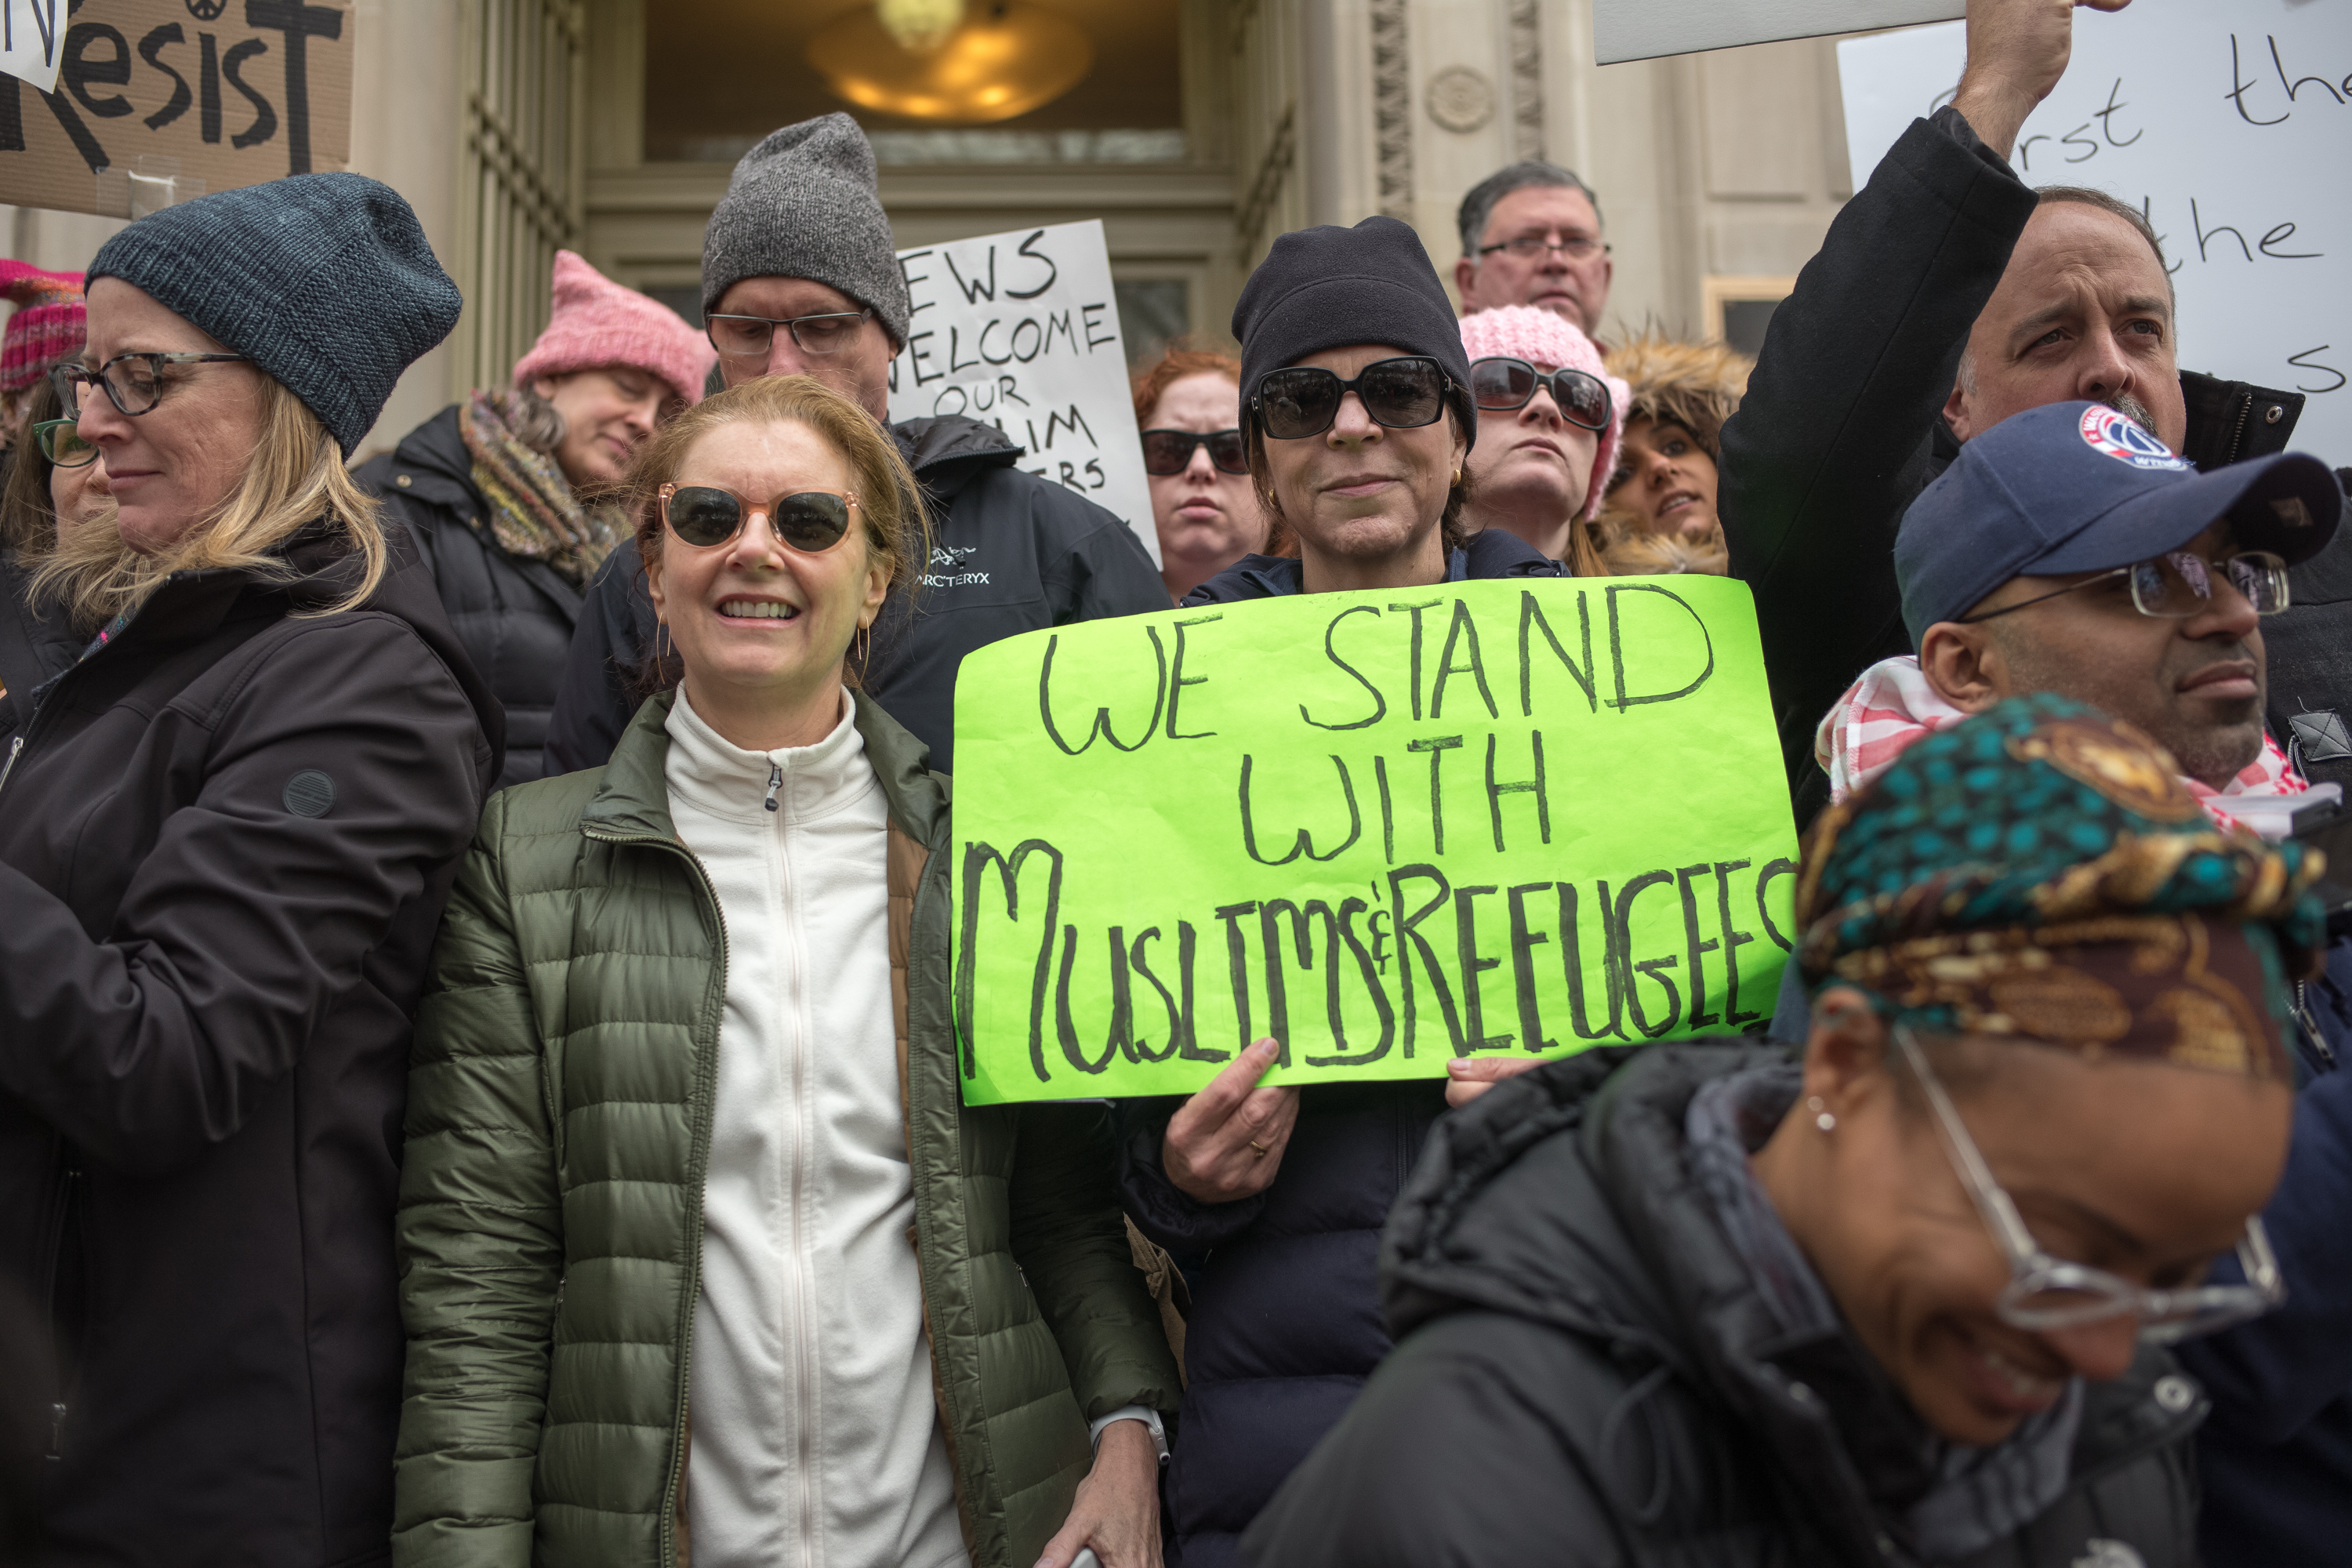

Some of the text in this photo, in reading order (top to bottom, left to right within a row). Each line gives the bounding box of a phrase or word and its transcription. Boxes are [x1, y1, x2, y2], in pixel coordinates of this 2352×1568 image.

[934, 376, 1030, 416] OUR
[1040, 583, 1714, 756] WE STAND
[1239, 729, 1551, 865] WITH
